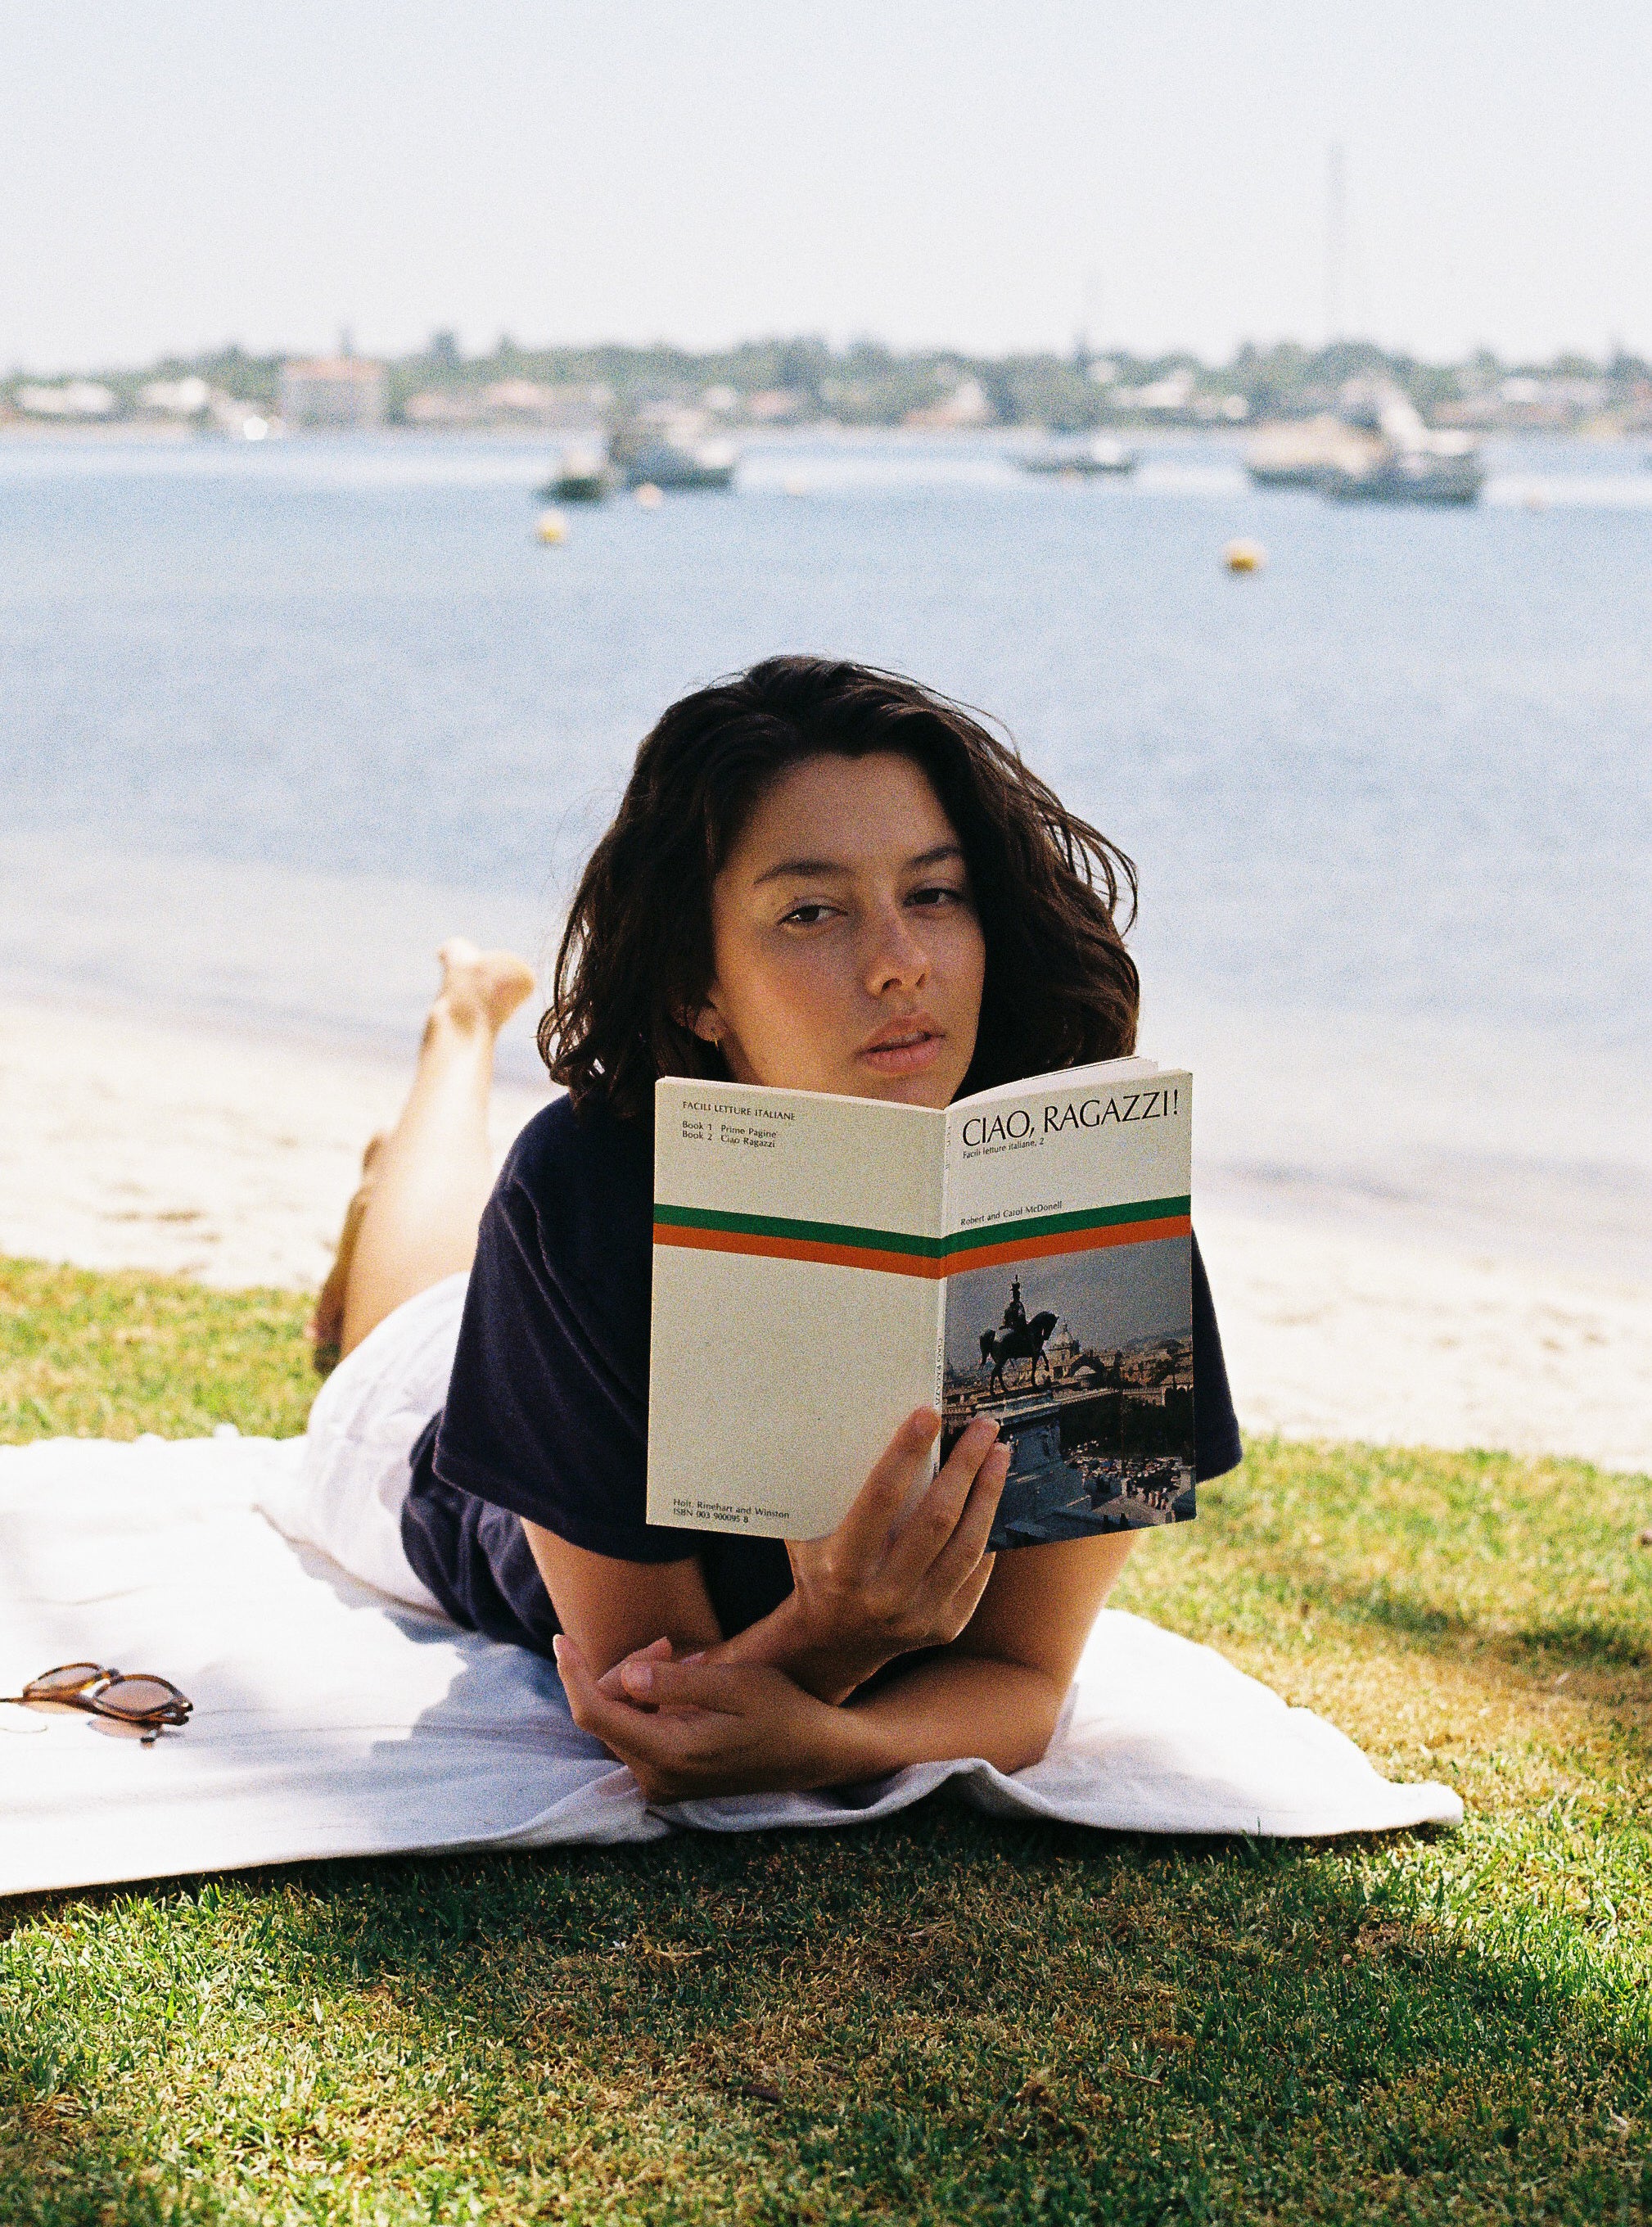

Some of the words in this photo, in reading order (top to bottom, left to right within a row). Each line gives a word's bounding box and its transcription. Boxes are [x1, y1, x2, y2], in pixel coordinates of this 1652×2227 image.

[683, 1101, 711, 1111] FACILI
[714, 1104, 752, 1116] LETTURE
[755, 1109, 797, 1121] ITALIANE
[962, 1110, 1035, 1147] CIAO,
[1044, 1089, 1179, 1133] RAGAZZI!
[682, 1120, 703, 1131] Book
[721, 1124, 745, 1135] Prime
[748, 1127, 777, 1139] Pagine
[682, 1130, 703, 1140] Book
[707, 1133, 712, 1141] 2
[721, 1134, 740, 1145] Ciao
[743, 1136, 775, 1148] Ragazzi
[963, 1148, 981, 1159] Facili
[982, 1145, 1007, 1156] letture
[1039, 1137, 1045, 1145] 2
[960, 1214, 985, 1226] Robert
[987, 1212, 1000, 1222] and
[1003, 1207, 1023, 1219] Carol
[1026, 1200, 1063, 1215] McDonell
[673, 1507, 693, 1517] ISBN
[697, 1501, 733, 1513] Rinehart
[736, 1506, 752, 1515] and
[755, 1507, 790, 1519] Winston
